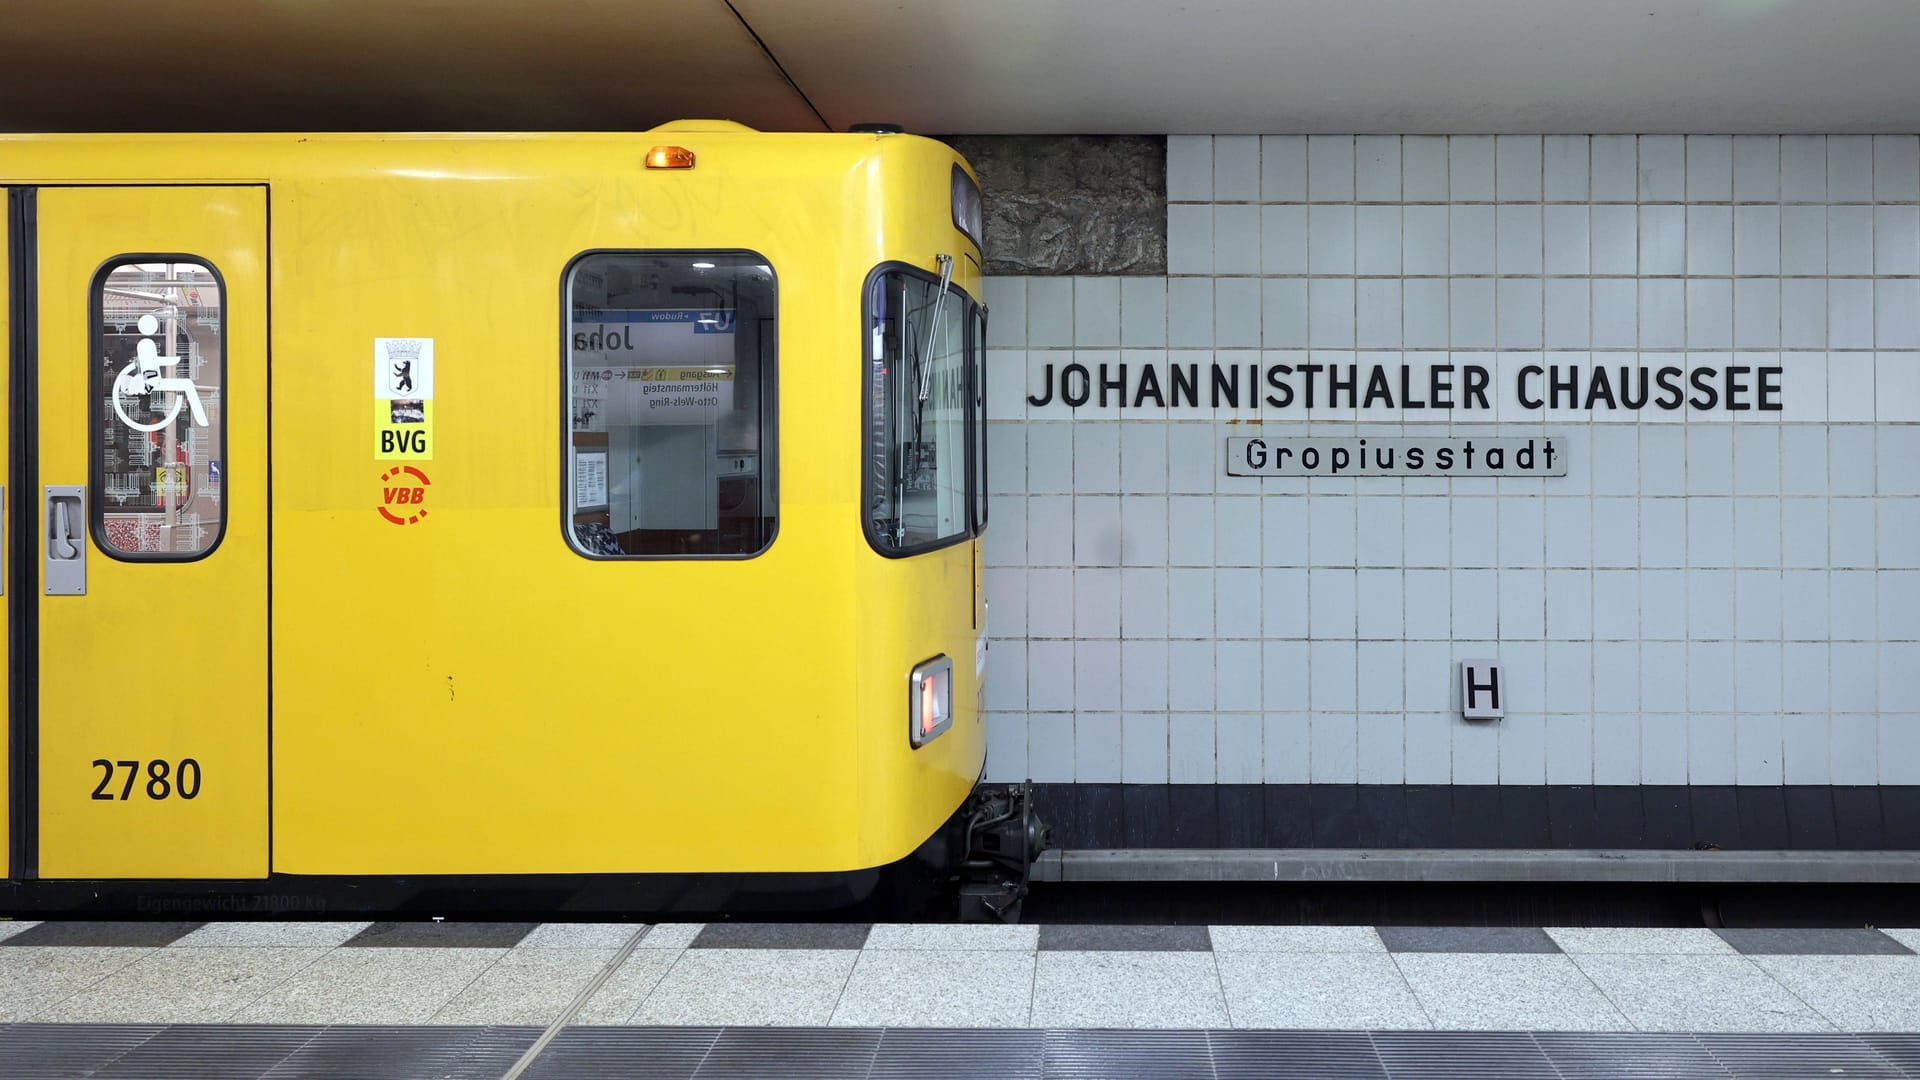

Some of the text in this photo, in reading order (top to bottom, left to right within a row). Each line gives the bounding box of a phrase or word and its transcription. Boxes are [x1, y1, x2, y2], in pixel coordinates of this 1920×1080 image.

[1027, 363, 1784, 411] JOHANNISTHALER CHAUSSEE
[381, 429, 426, 454] BVG
[1245, 439, 1556, 474] Gropiusstadt
[383, 487, 425, 505] VBB
[1466, 667, 1500, 710] H
[91, 758, 201, 801] 2780
[136, 894, 248, 914] Eigengewicht
